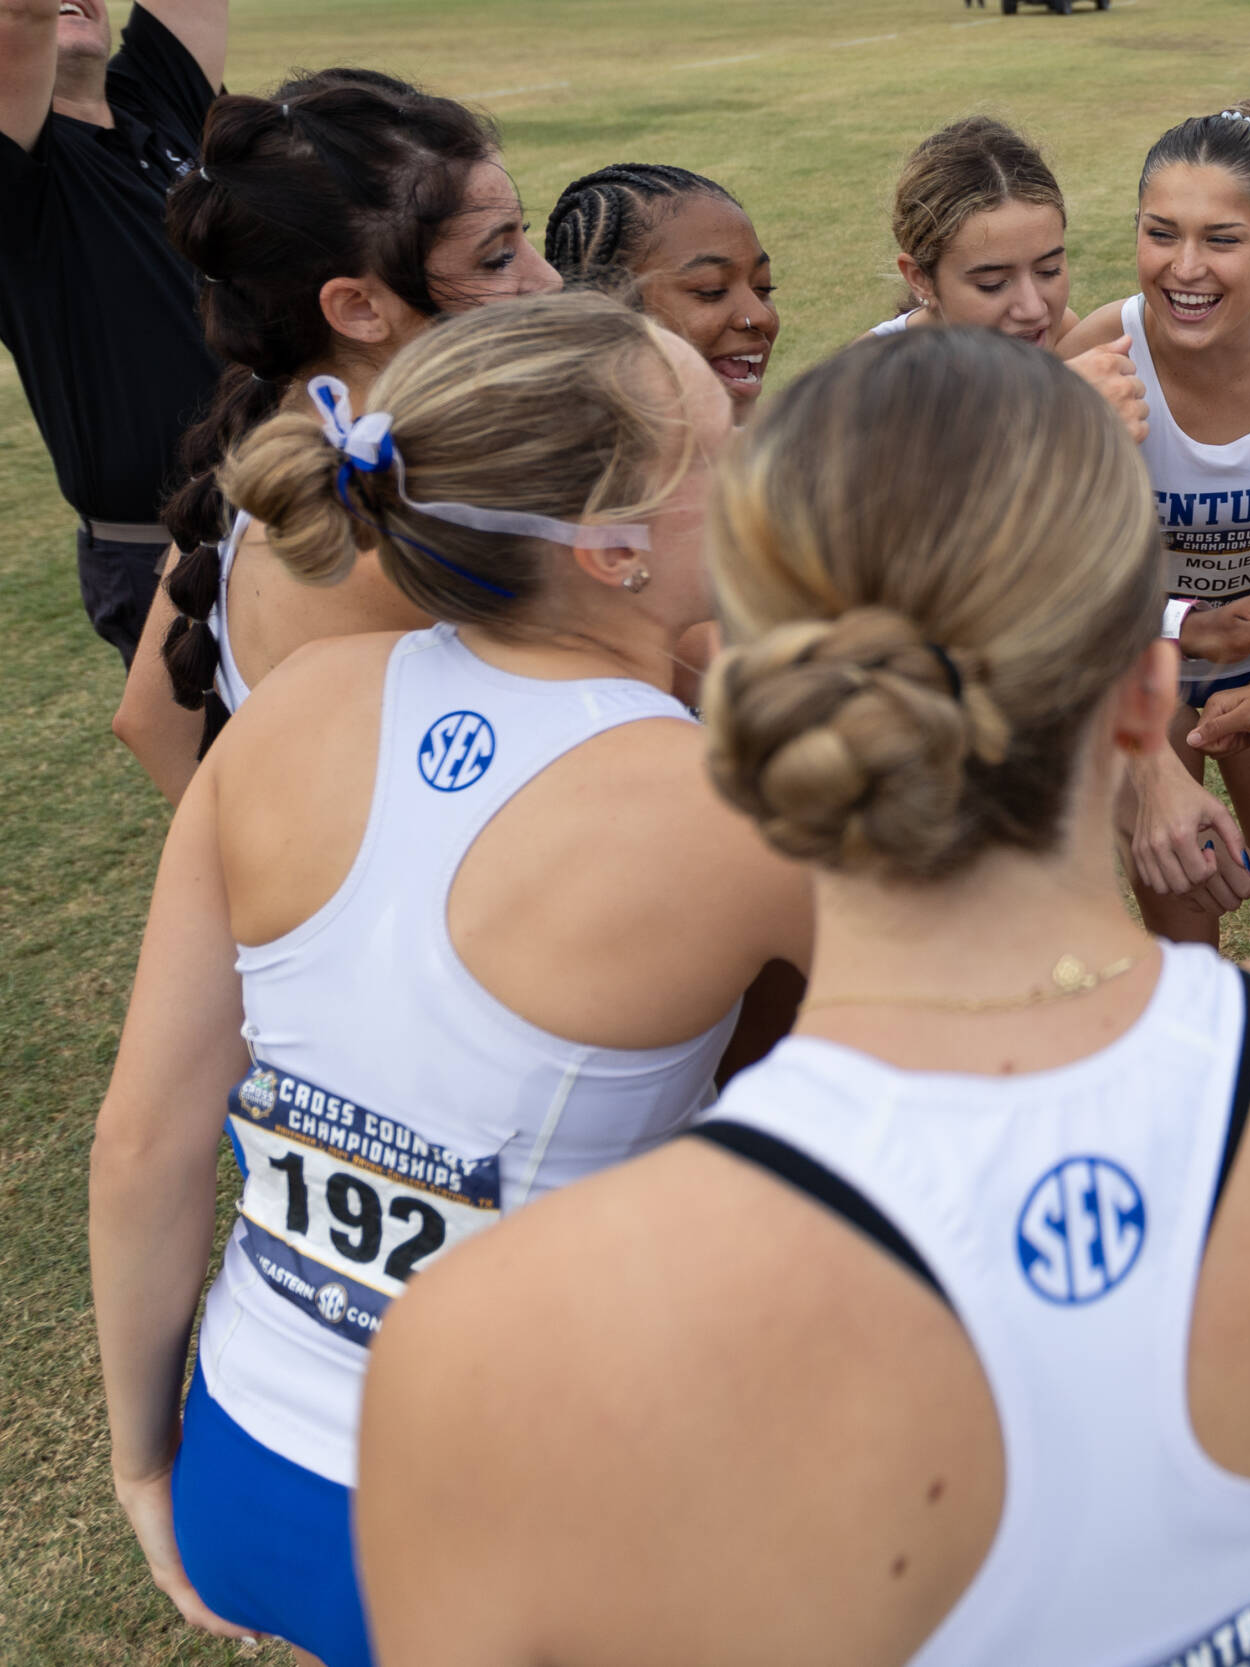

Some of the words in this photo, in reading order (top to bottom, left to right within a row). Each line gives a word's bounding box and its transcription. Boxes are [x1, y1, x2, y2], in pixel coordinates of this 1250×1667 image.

[1177, 532, 1221, 542] CROSS
[418, 711, 495, 793] SEC
[279, 1078, 356, 1126] CROSS
[365, 1112, 478, 1177] COUNTRY
[288, 1109, 462, 1192] CHAMPIONSHIPS
[268, 1151, 446, 1283] 192
[1015, 1155, 1147, 1307] SEC
[316, 1283, 347, 1323] SEC
